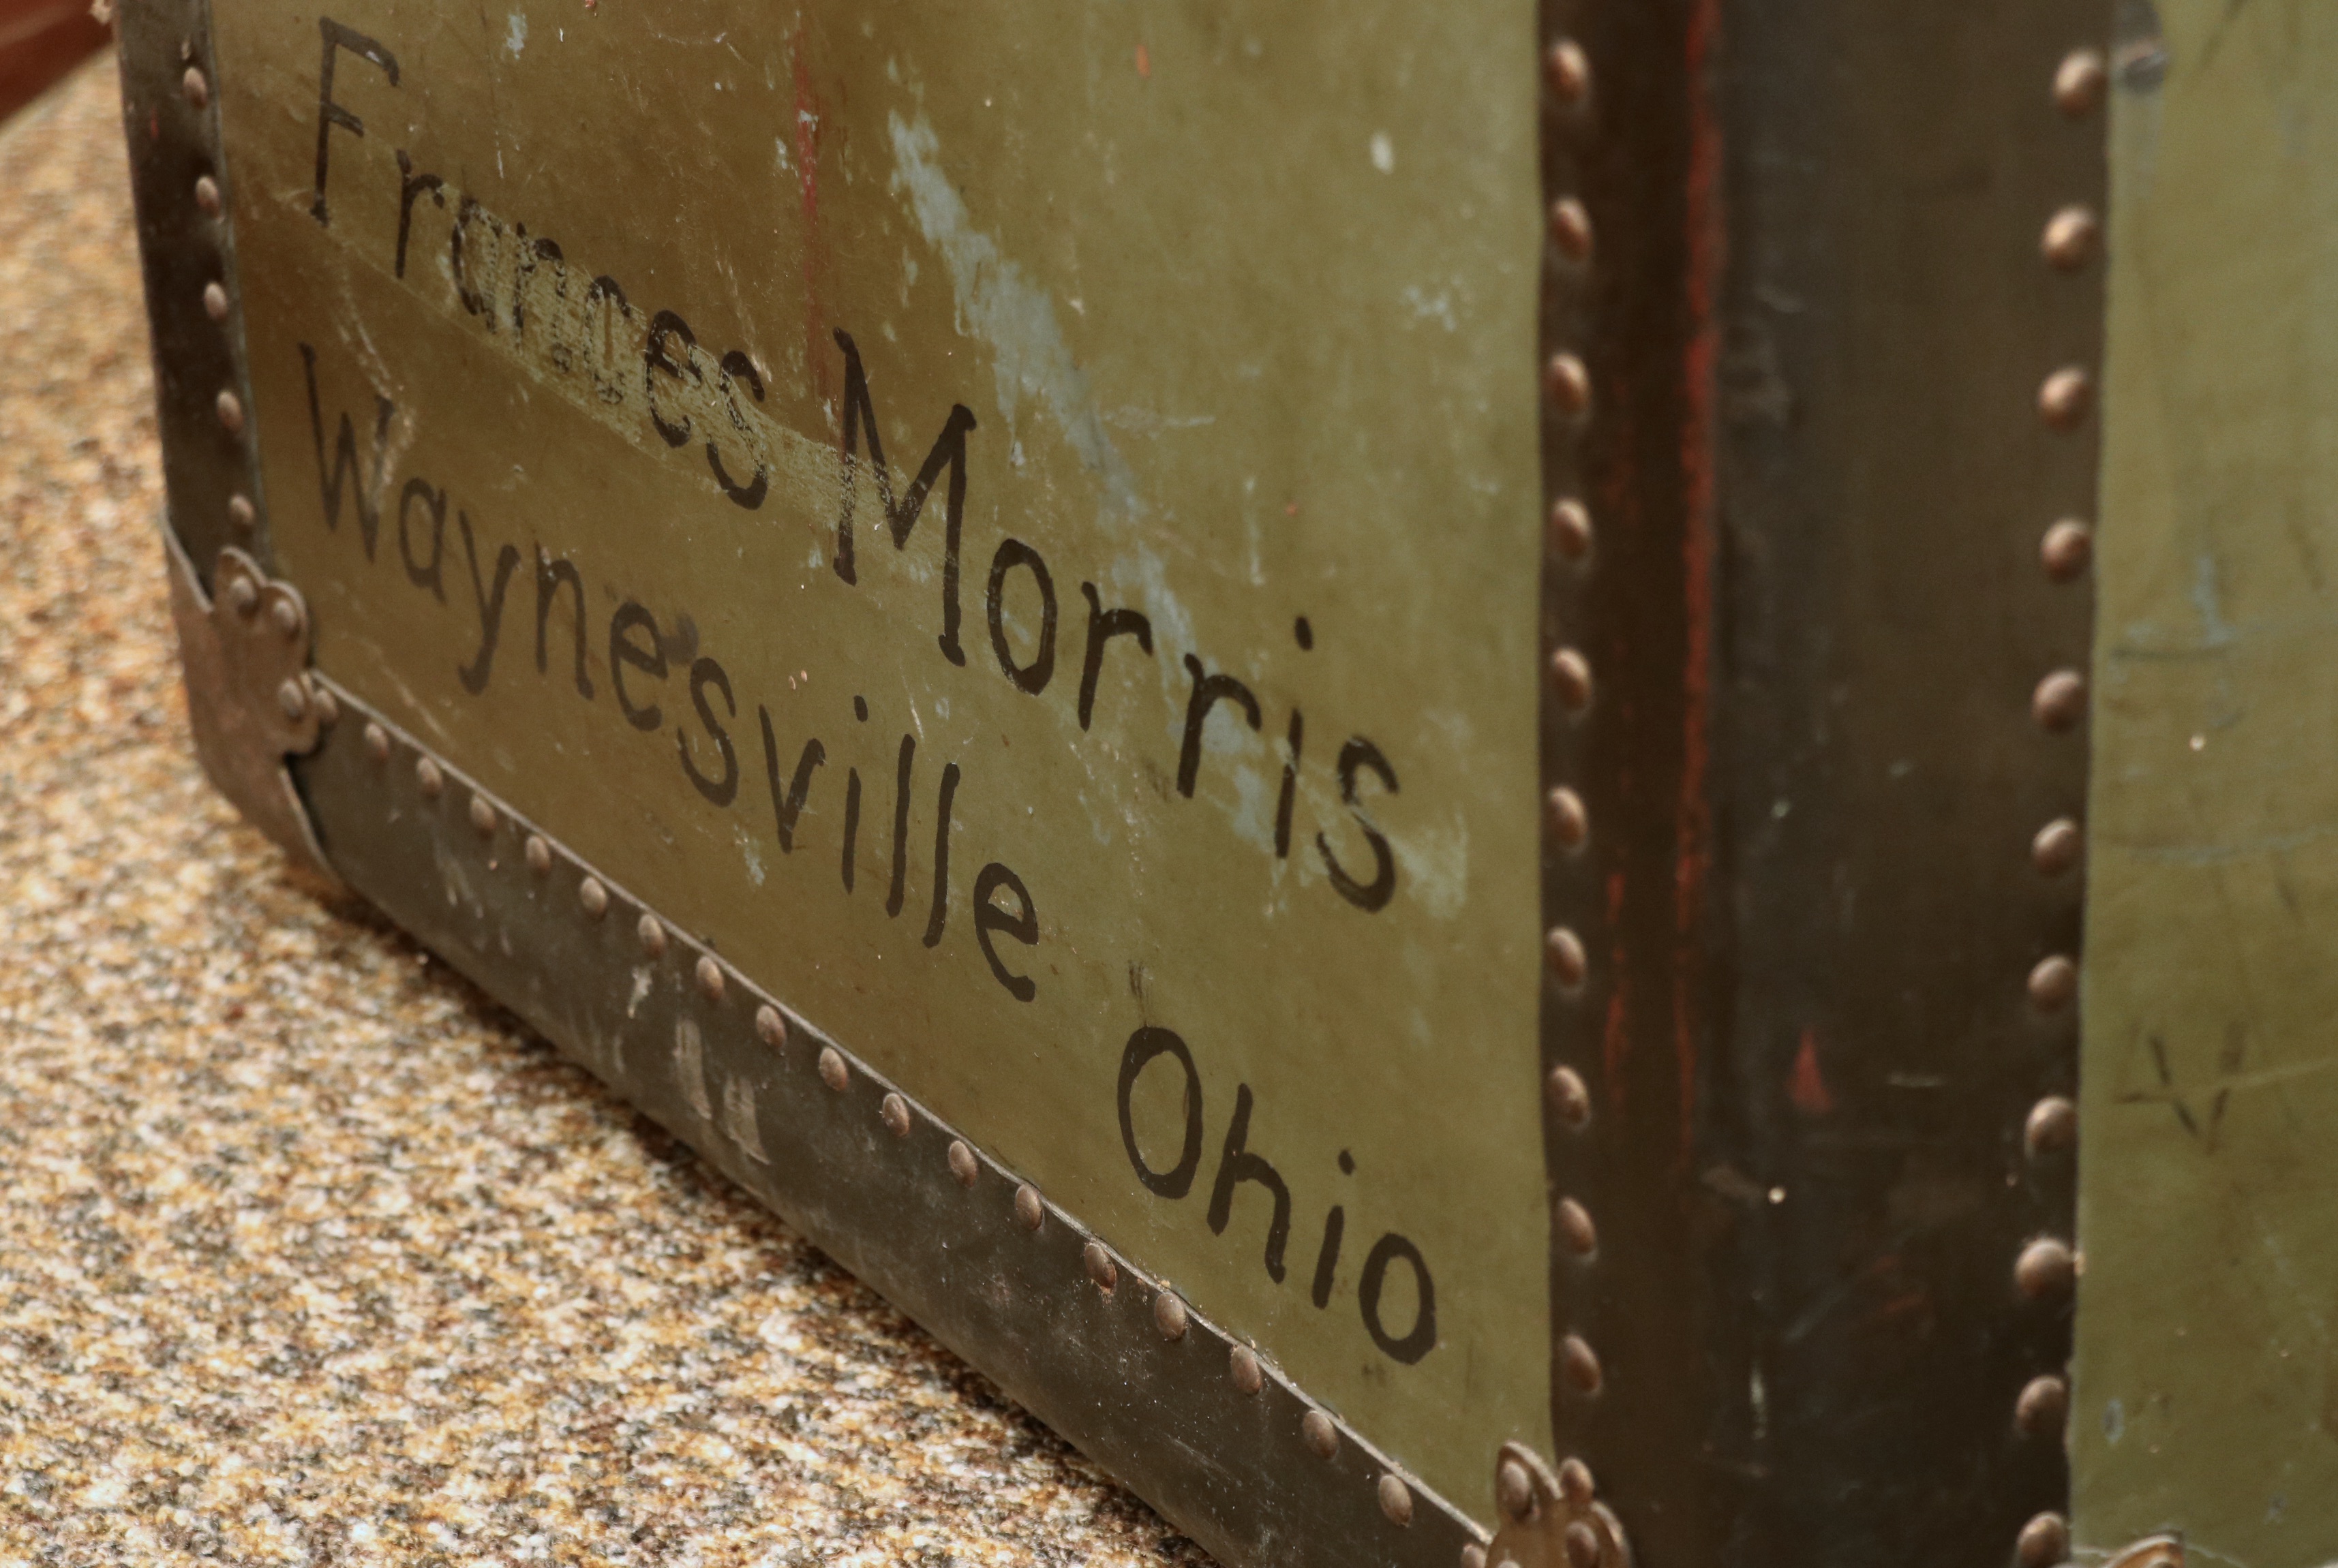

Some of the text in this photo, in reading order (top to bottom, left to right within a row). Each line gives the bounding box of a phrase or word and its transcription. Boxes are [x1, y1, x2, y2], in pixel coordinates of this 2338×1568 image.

[299, 342, 1436, 1365] Waynesville Ohio
[310, 17, 1400, 913] Frances Morris
